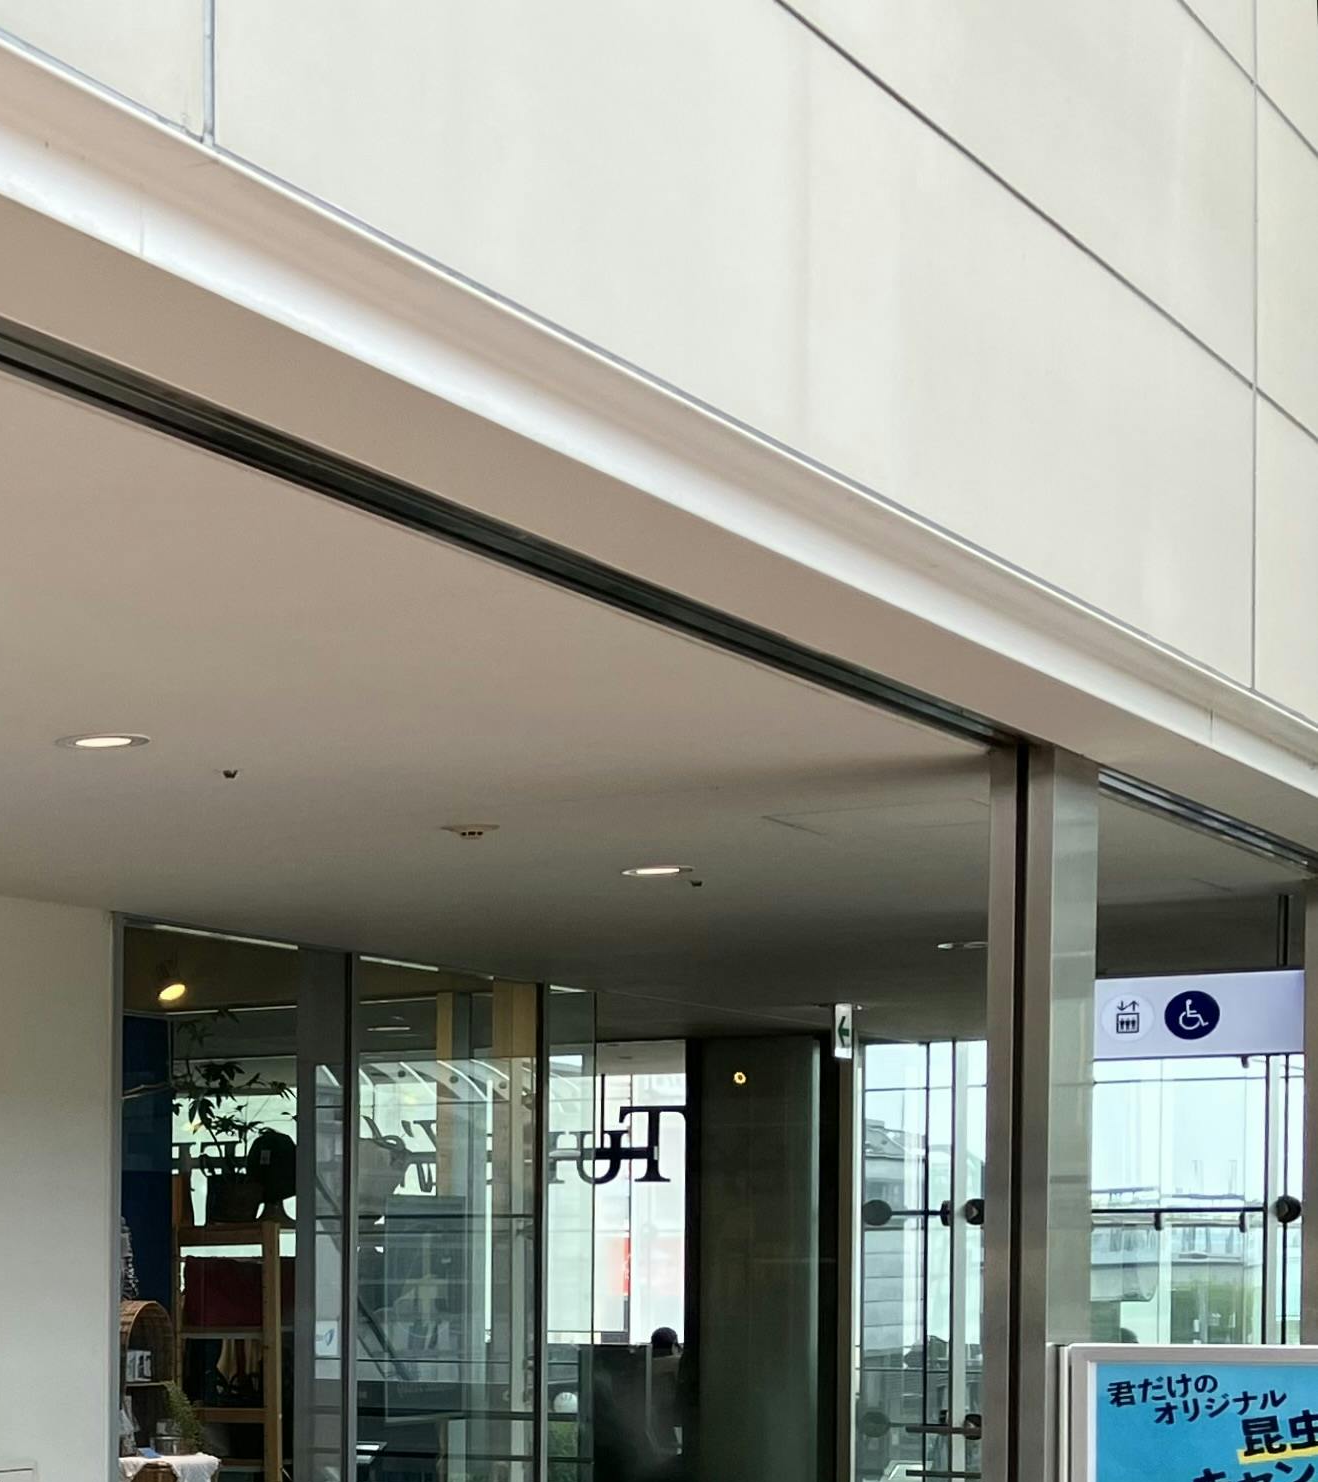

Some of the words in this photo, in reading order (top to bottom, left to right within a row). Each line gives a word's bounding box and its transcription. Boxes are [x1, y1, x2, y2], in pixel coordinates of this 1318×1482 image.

[1108, 1374, 1218, 1407] 君だけの
[1154, 1390, 1287, 1425] オリジナル
